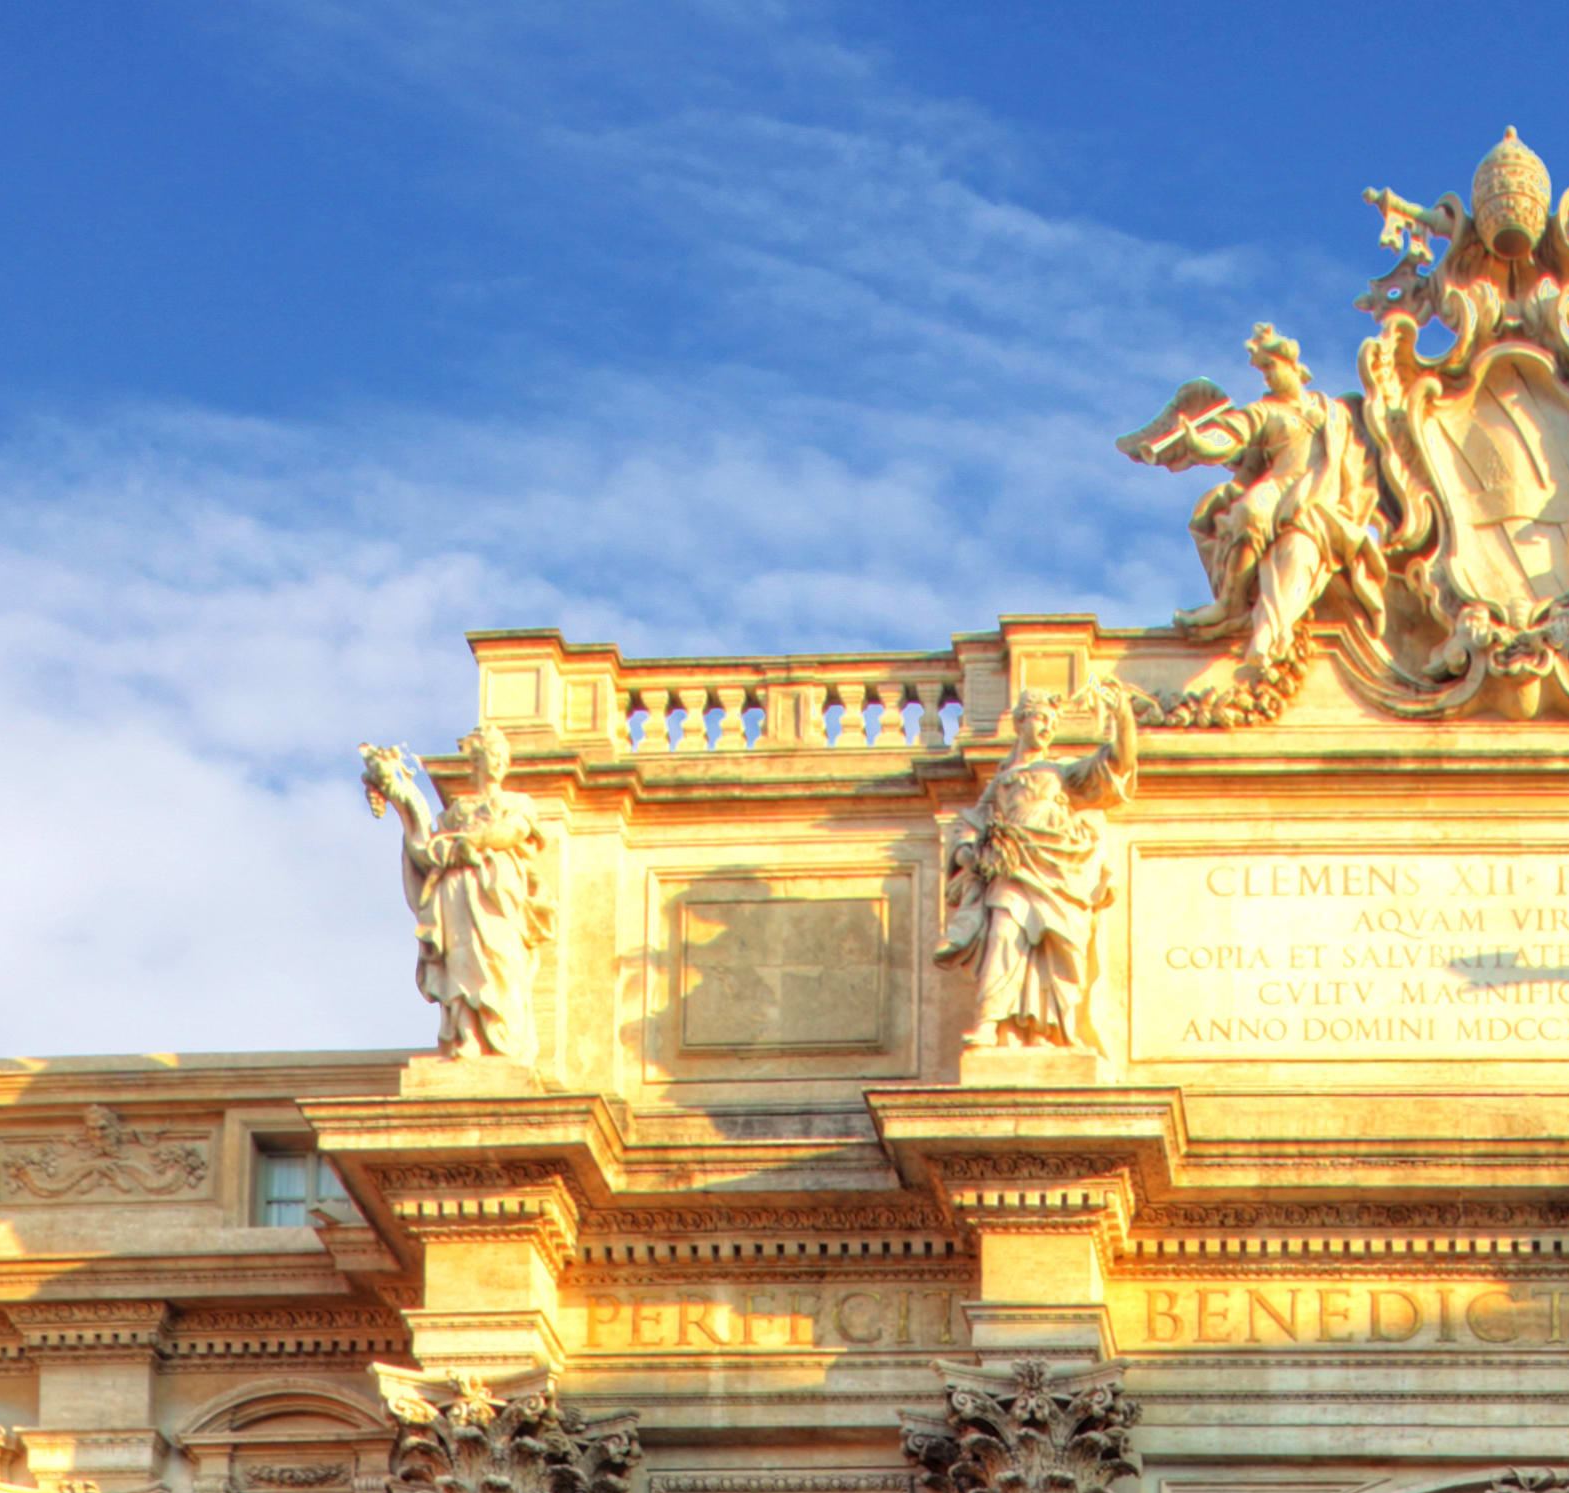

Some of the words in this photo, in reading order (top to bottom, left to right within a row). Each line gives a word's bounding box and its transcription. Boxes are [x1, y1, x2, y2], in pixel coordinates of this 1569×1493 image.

[1206, 865, 1420, 897] CLEMENS
[1352, 909, 1485, 940] AQVAM
[1165, 946, 1271, 970] COPIA
[1289, 945, 1328, 969] ET
[1258, 981, 1374, 1005] CVLTV
[1182, 1018, 1287, 1042] ANNO
[1303, 1018, 1434, 1042] DOMINI
[581, 1289, 972, 1348] PERFECIT
